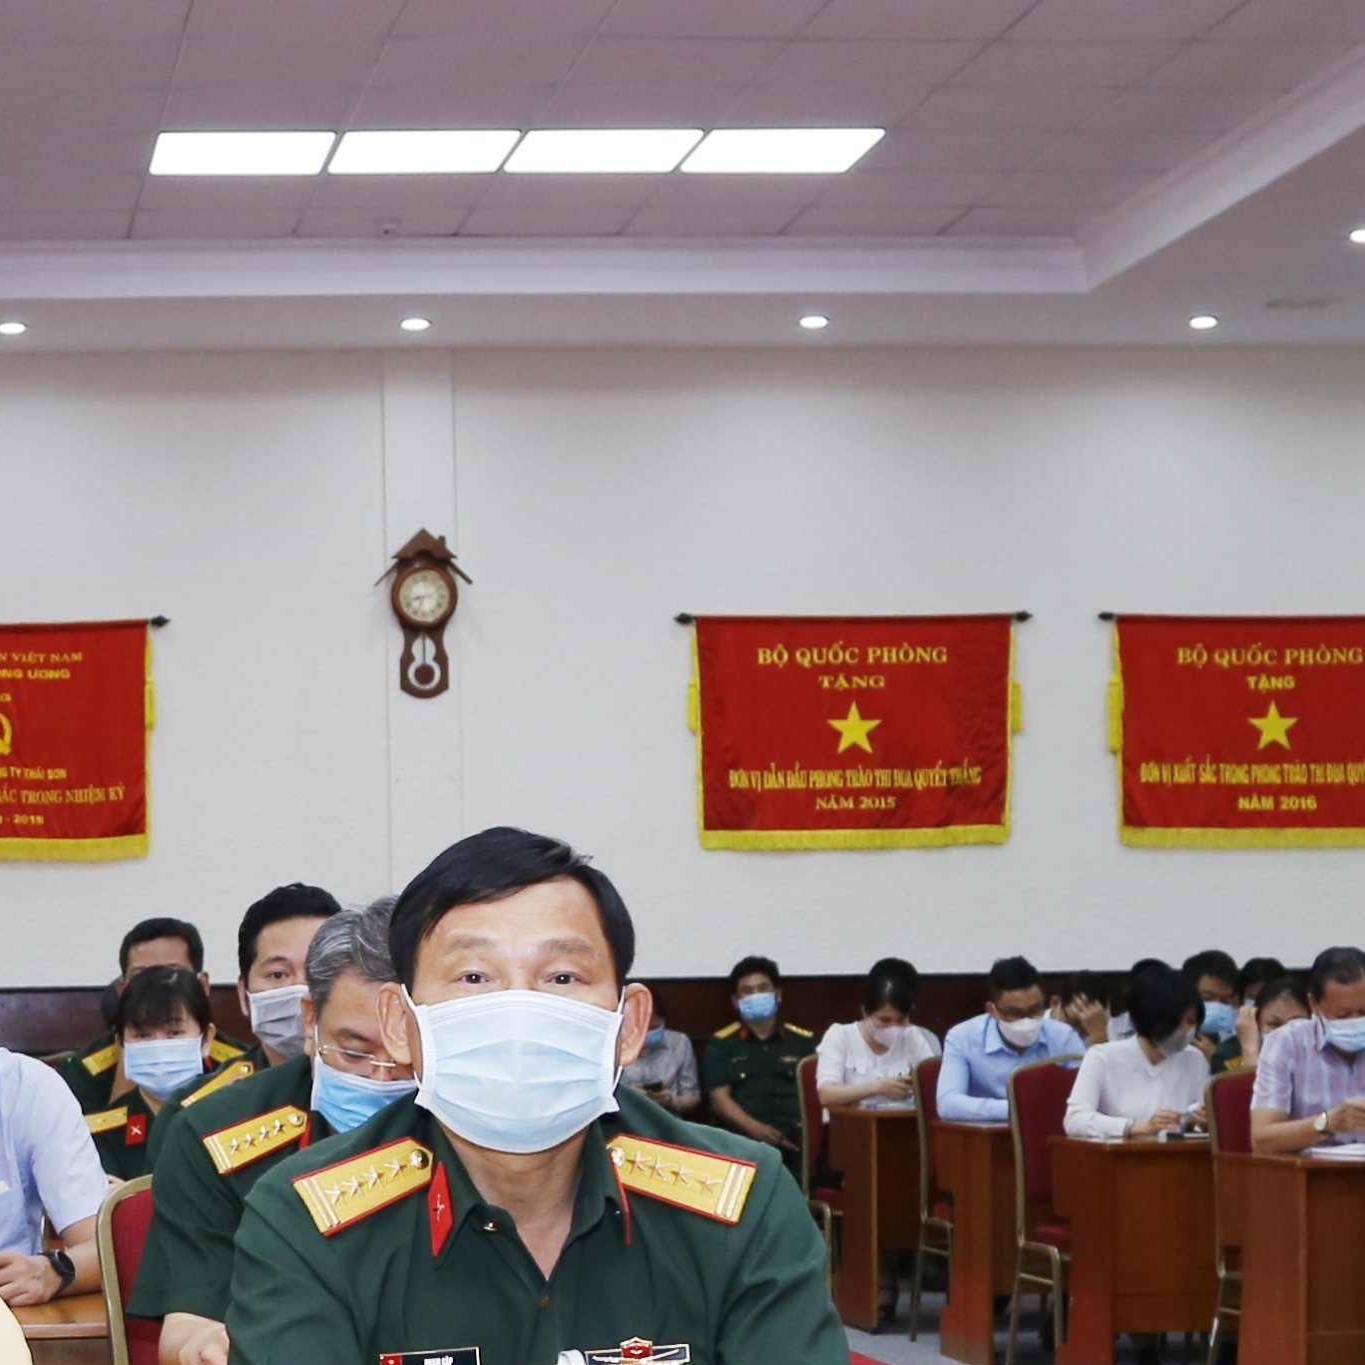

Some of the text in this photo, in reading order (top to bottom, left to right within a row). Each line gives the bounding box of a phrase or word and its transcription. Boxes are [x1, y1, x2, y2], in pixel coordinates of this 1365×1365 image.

[50, 652, 82, 663] NAM
[757, 641, 947, 668] BỘ QUỐC PHÒNG
[1177, 642, 1364, 669] BỘ QUỐC PHÒNG
[818, 673, 885, 691] TẶNG
[1246, 673, 1296, 693] TẶNG
[815, 794, 896, 810] NĂM 2015
[1280, 795, 1317, 810] 2016
